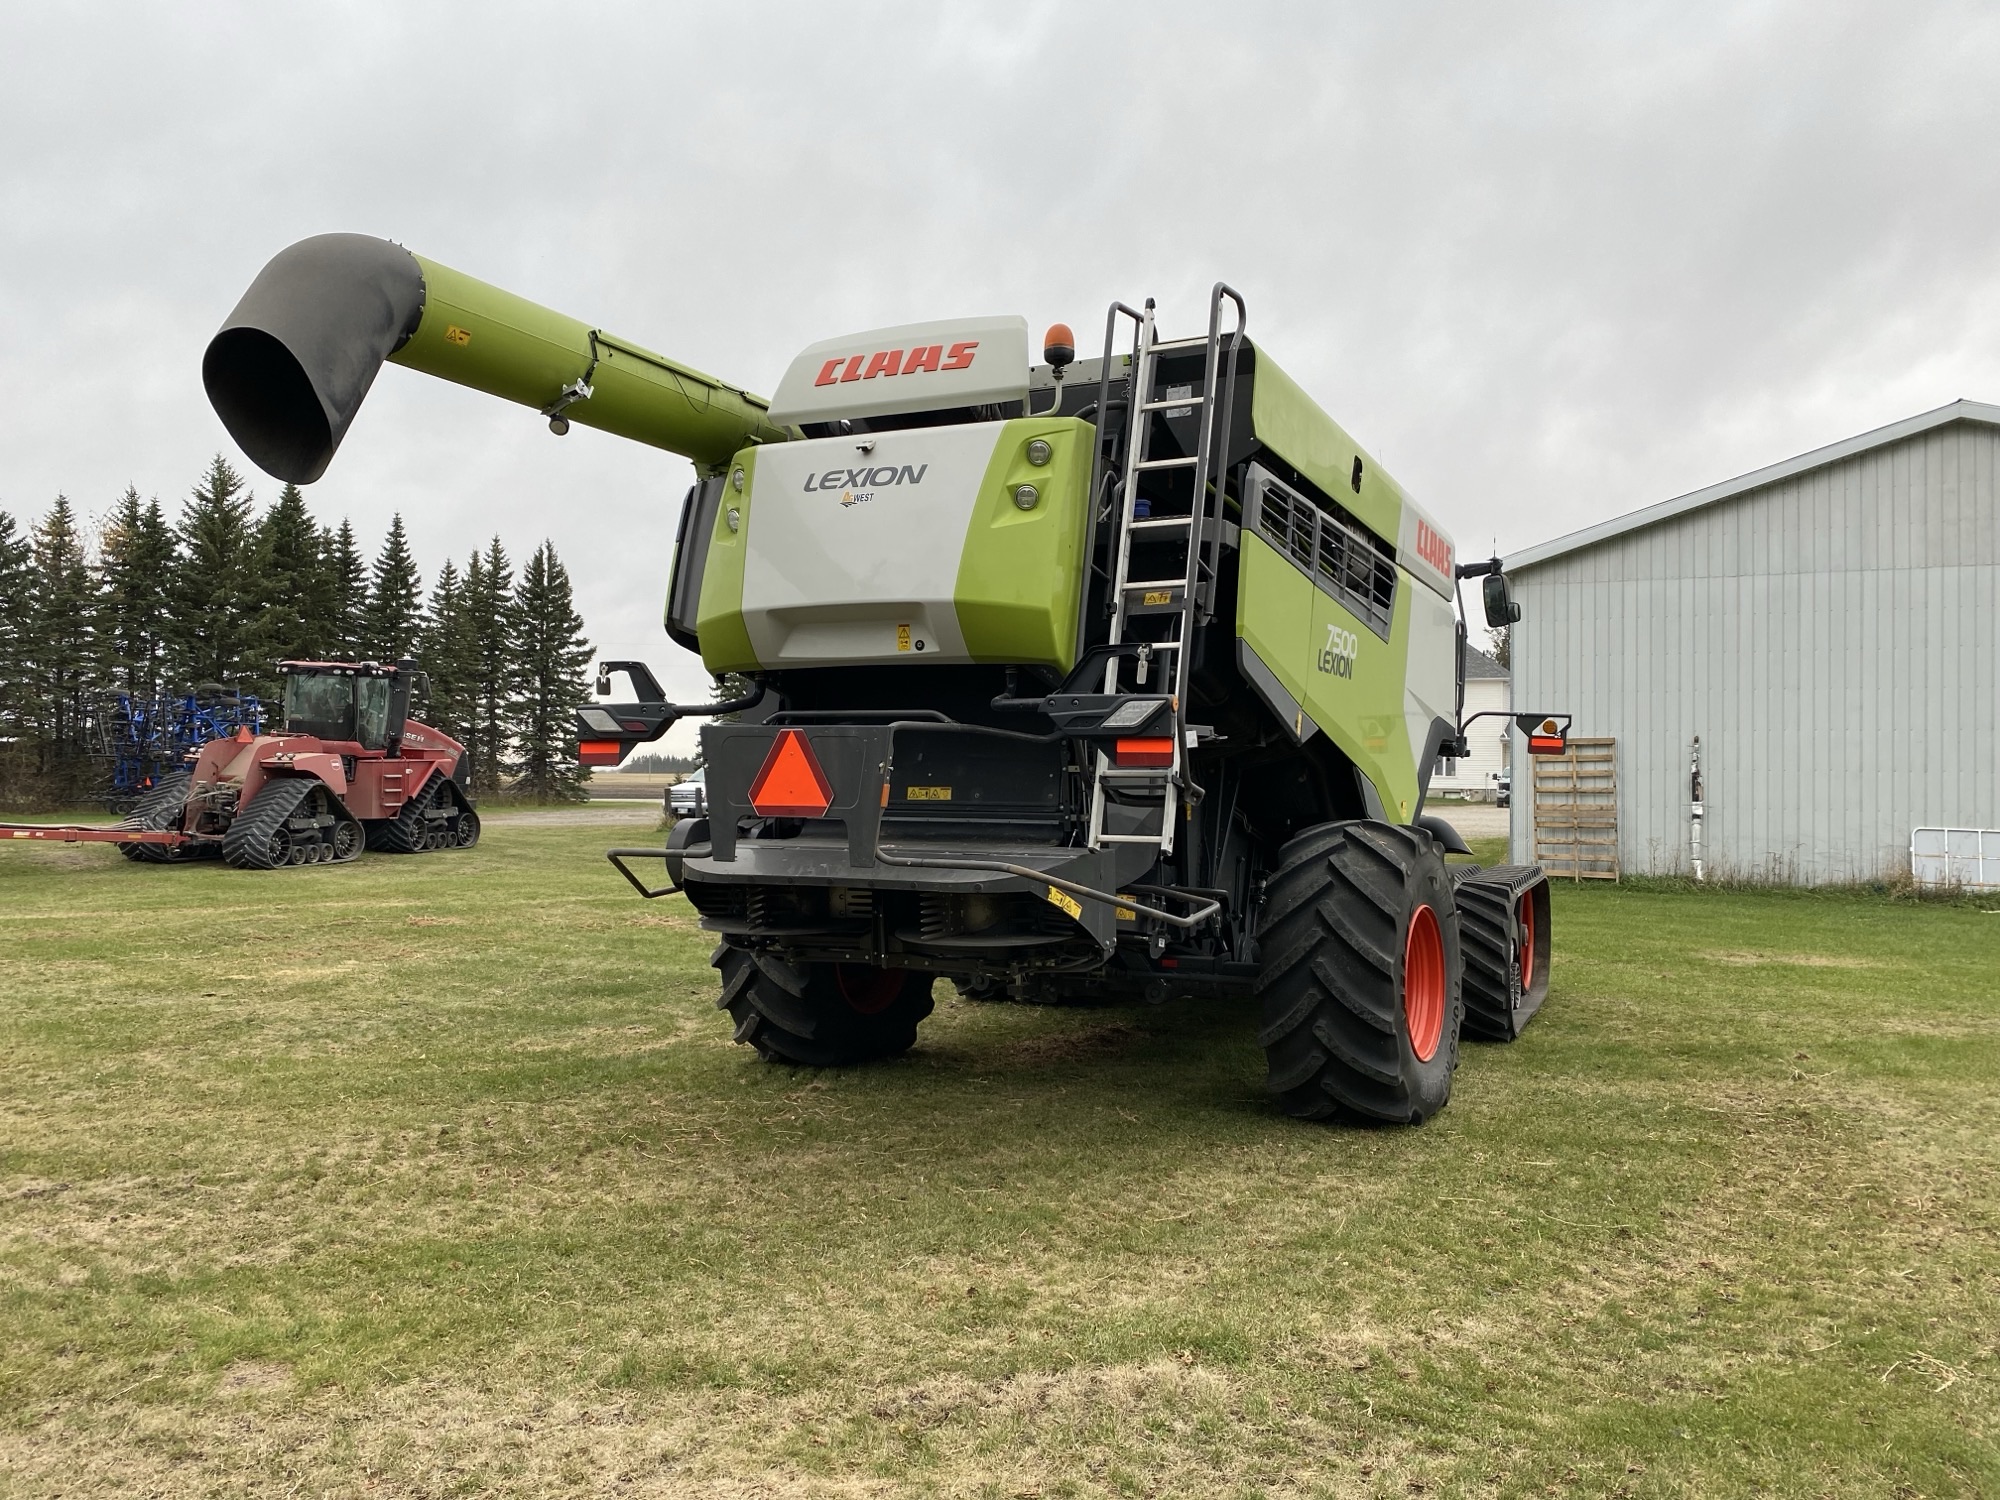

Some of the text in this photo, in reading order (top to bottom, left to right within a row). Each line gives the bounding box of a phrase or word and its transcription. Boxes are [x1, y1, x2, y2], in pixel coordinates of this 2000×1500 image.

[814, 341, 980, 387] CLAAS
[803, 464, 929, 492] LEXION
[1416, 518, 1451, 578] CLAAS
[1325, 623, 1358, 660] 7500
[1317, 648, 1353, 681] LEXION
